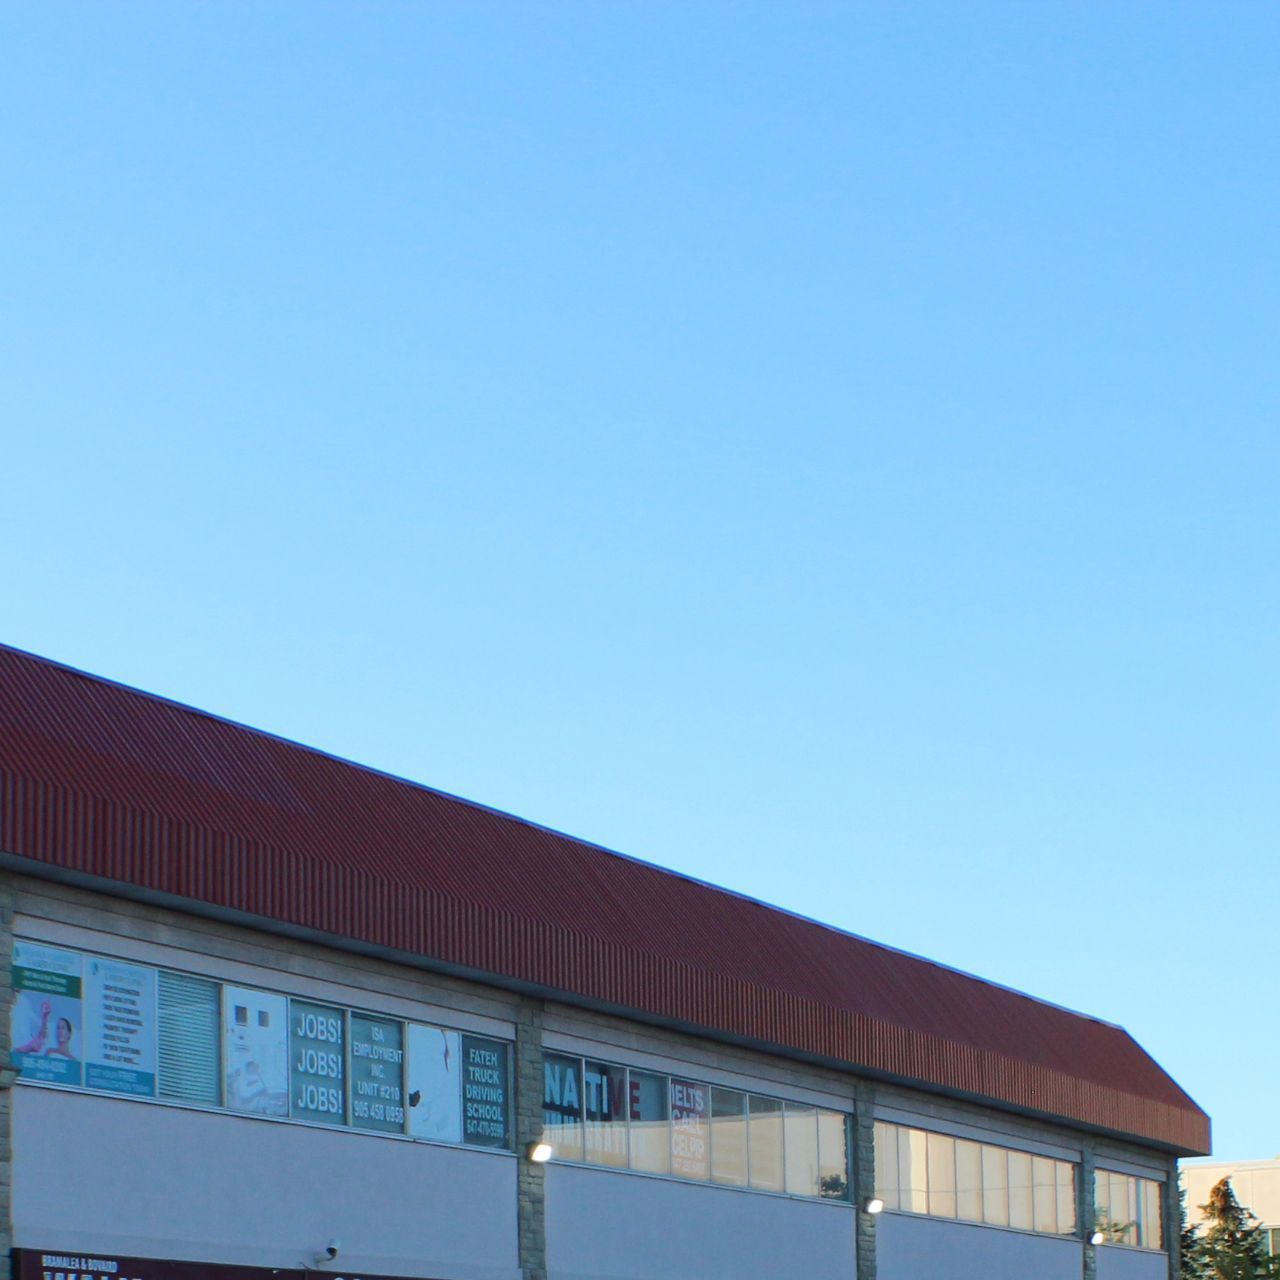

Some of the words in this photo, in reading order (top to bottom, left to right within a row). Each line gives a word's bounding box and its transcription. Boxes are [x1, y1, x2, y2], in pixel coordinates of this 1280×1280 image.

[297, 1013, 342, 1044] JOBS!
[371, 1026, 384, 1042] ISA
[353, 1042, 403, 1063] EMPLOYMENT
[469, 1048, 497, 1066] FATEH
[297, 1049, 342, 1079] JOBS!
[468, 1066, 499, 1084] TRUCK
[297, 1084, 342, 1114] JOBS!
[358, 1081, 378, 1097] UNIT
[466, 1084, 503, 1103] DRIVING
[544, 1062, 641, 1120] NATIVE
[671, 1082, 704, 1111] IELTS
[466, 1103, 503, 1121] SCHOOL
